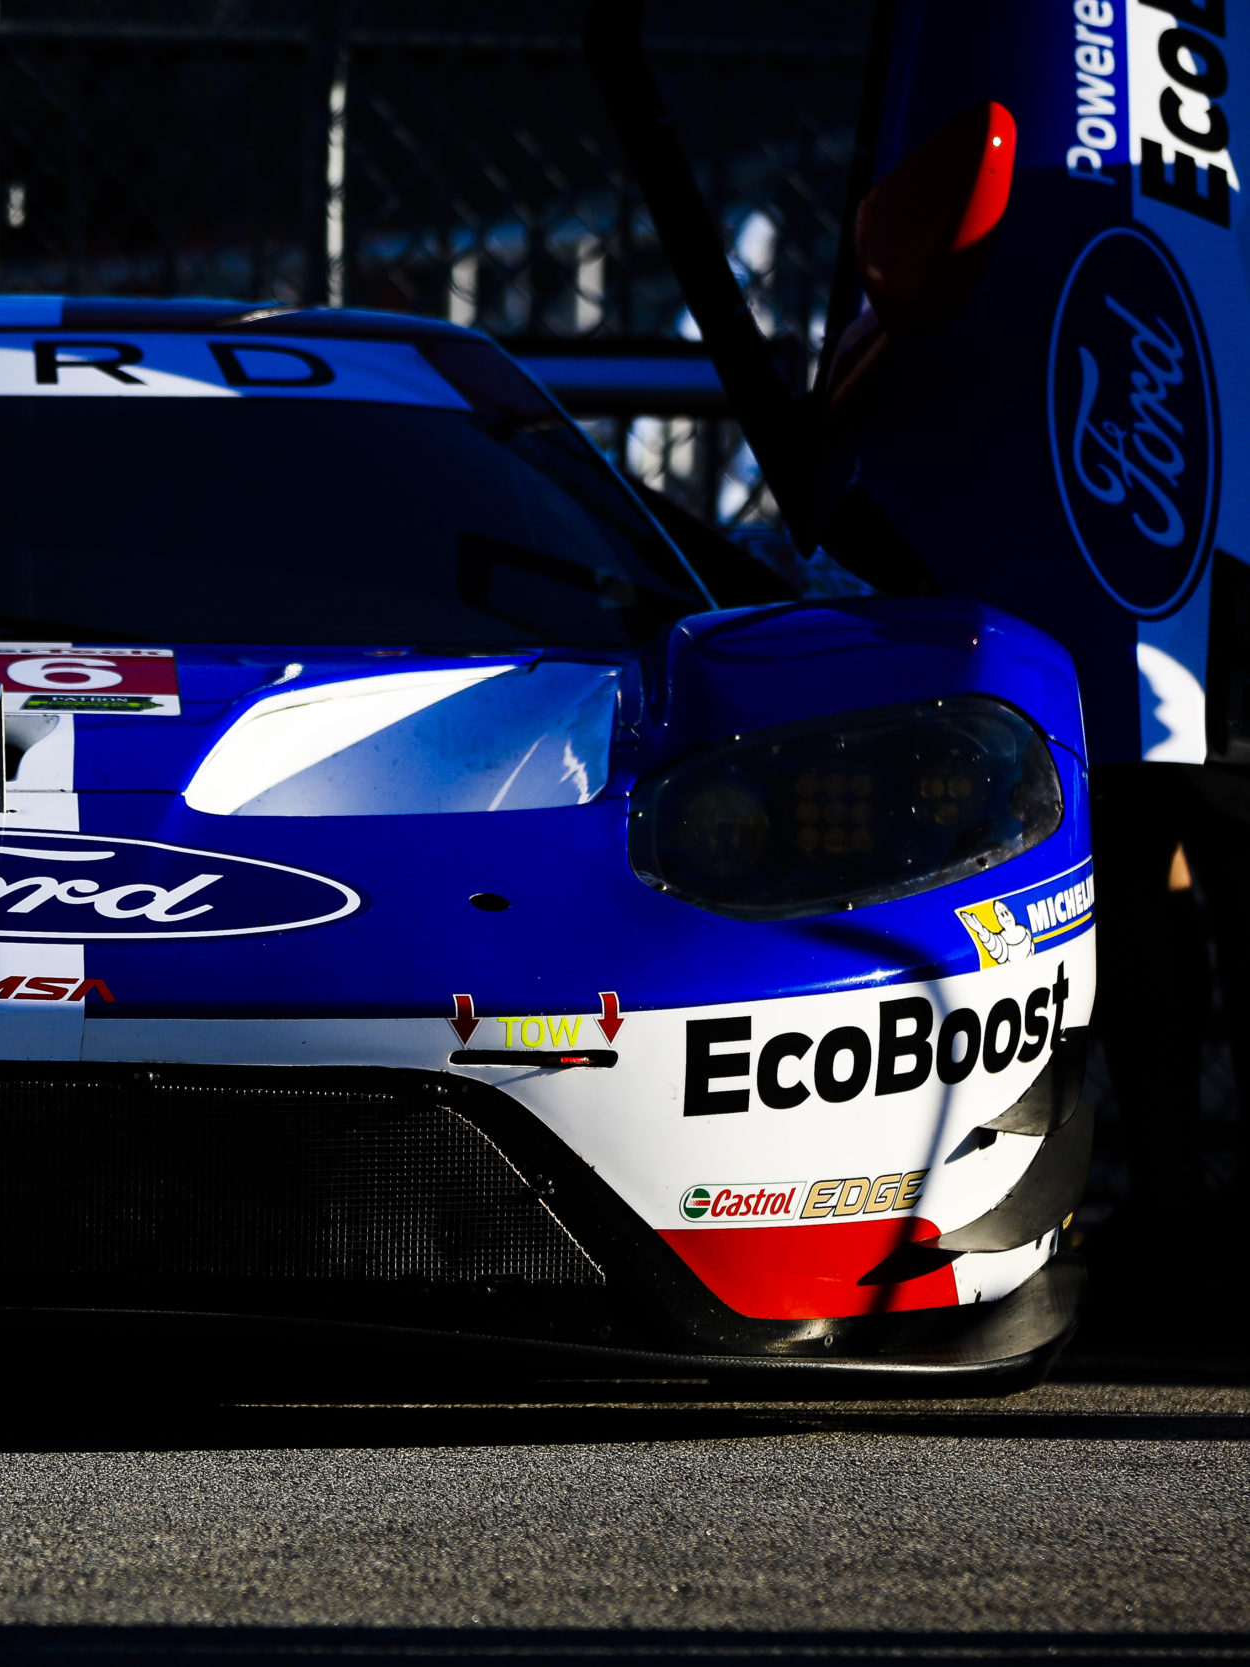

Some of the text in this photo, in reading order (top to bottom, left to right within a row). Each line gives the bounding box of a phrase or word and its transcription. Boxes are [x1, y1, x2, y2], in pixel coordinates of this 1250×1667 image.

[1072, 294, 1186, 549] Ford
[497, 1017, 583, 1047] TOW
[683, 961, 1070, 1117] EcoBoost
[711, 1168, 932, 1219] Castrol EDGE
